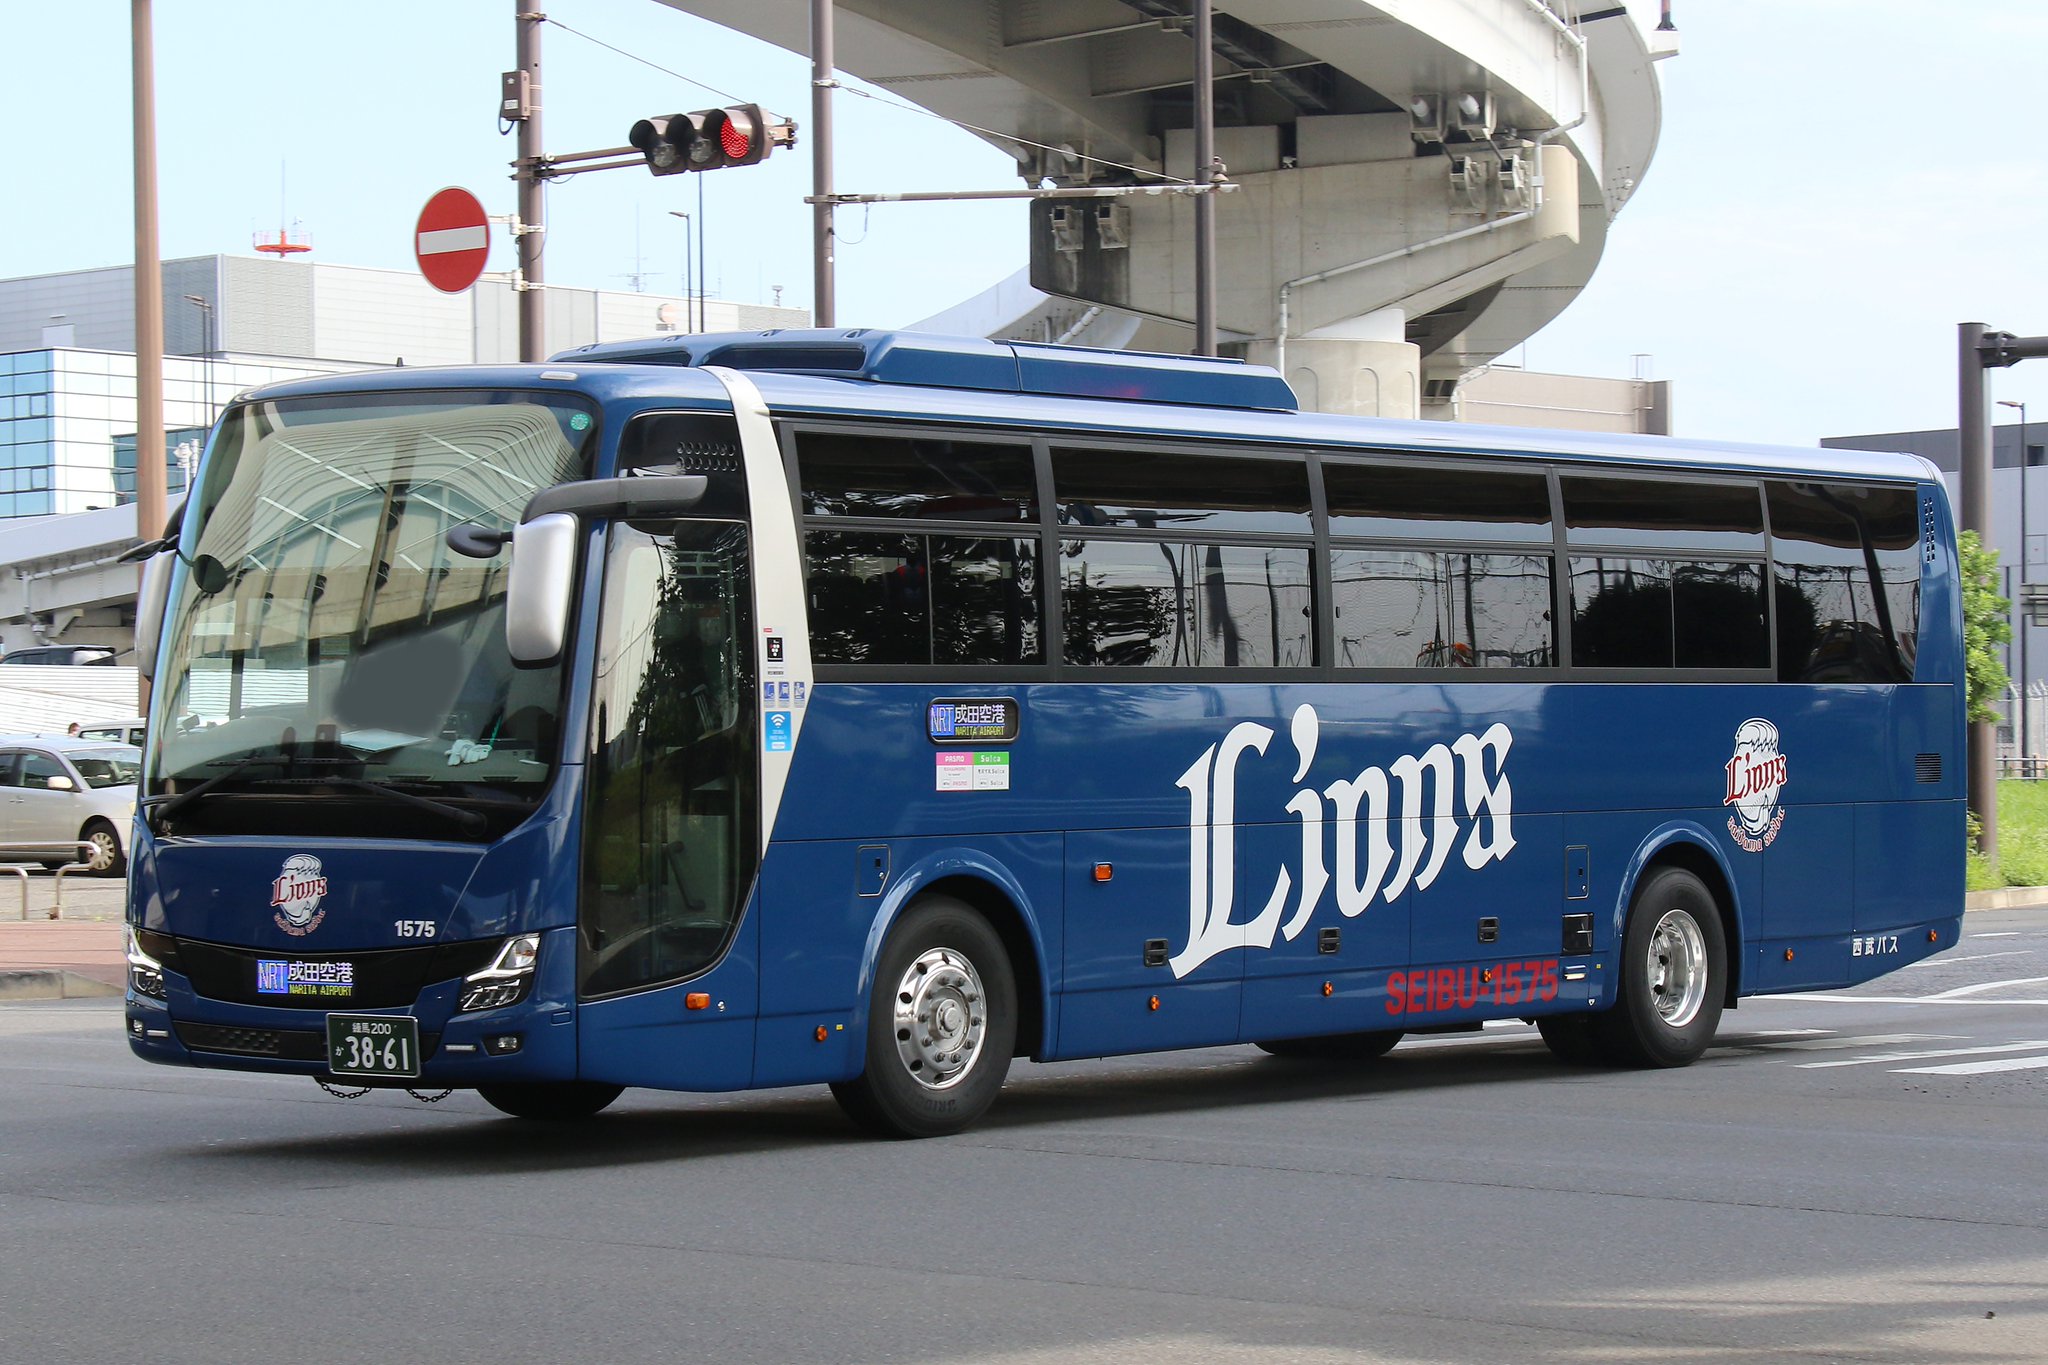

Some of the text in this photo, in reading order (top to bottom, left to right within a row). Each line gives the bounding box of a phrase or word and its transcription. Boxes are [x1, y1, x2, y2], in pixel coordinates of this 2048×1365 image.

[931, 707, 954, 732] NRT
[954, 704, 1005, 723] 成田空港
[955, 726, 1005, 736] NARITA AIRPORT
[980, 754, 1001, 762] Suica
[1723, 751, 1787, 806] Lions
[1168, 703, 1517, 980] Lions
[270, 874, 327, 906] Lions
[394, 920, 436, 937] 1575
[1852, 935, 1898, 957] 西武バス
[258, 962, 287, 990] NRT
[287, 961, 353, 983] 成田空港
[289, 984, 353, 997] NARITA AIRPORT
[1385, 960, 1559, 1015] SEIBU-1575
[345, 1035, 409, 1070] 38-61
